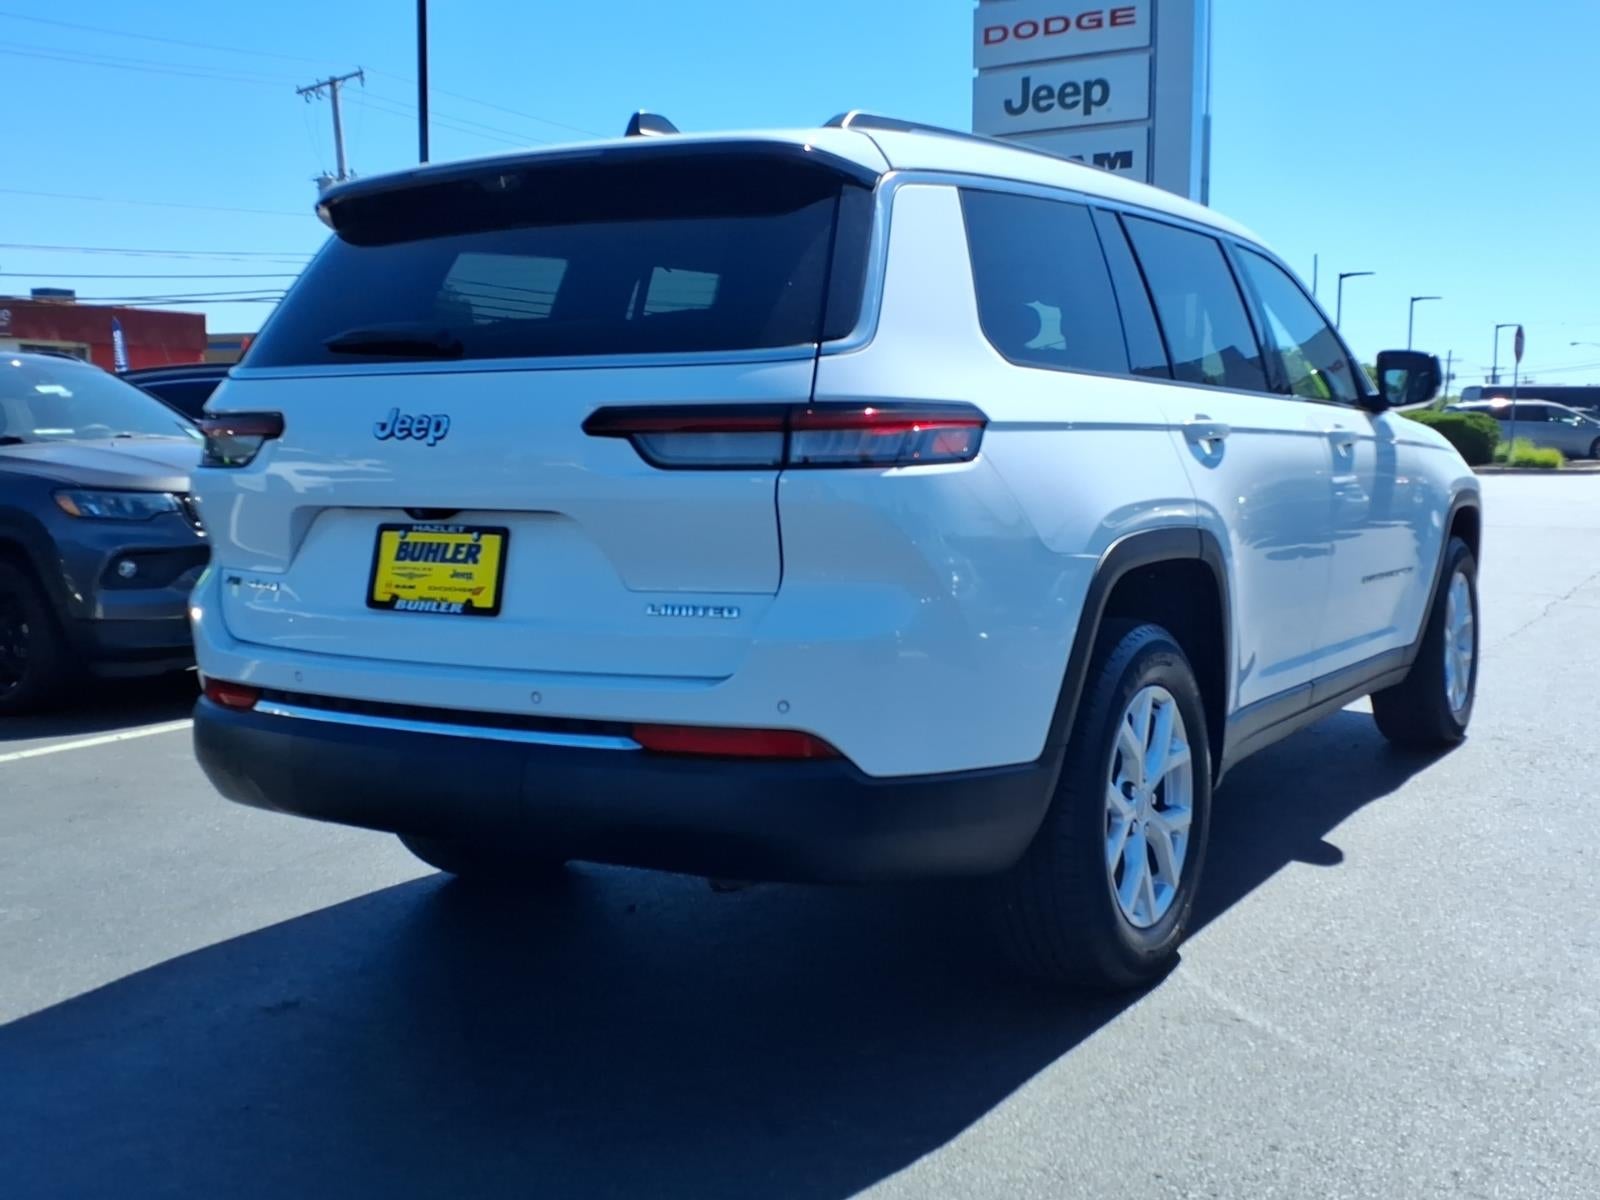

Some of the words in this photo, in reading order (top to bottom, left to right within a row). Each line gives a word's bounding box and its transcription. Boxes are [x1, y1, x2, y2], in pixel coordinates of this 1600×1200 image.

[983, 6, 1136, 46] DODGE
[1004, 75, 1111, 117] Jeep
[373, 407, 450, 446] Jeep
[411, 524, 466, 534] HAZLET
[394, 541, 483, 565] BUHLER
[394, 599, 463, 614] BUHLER
[646, 603, 741, 619] LIMITED
